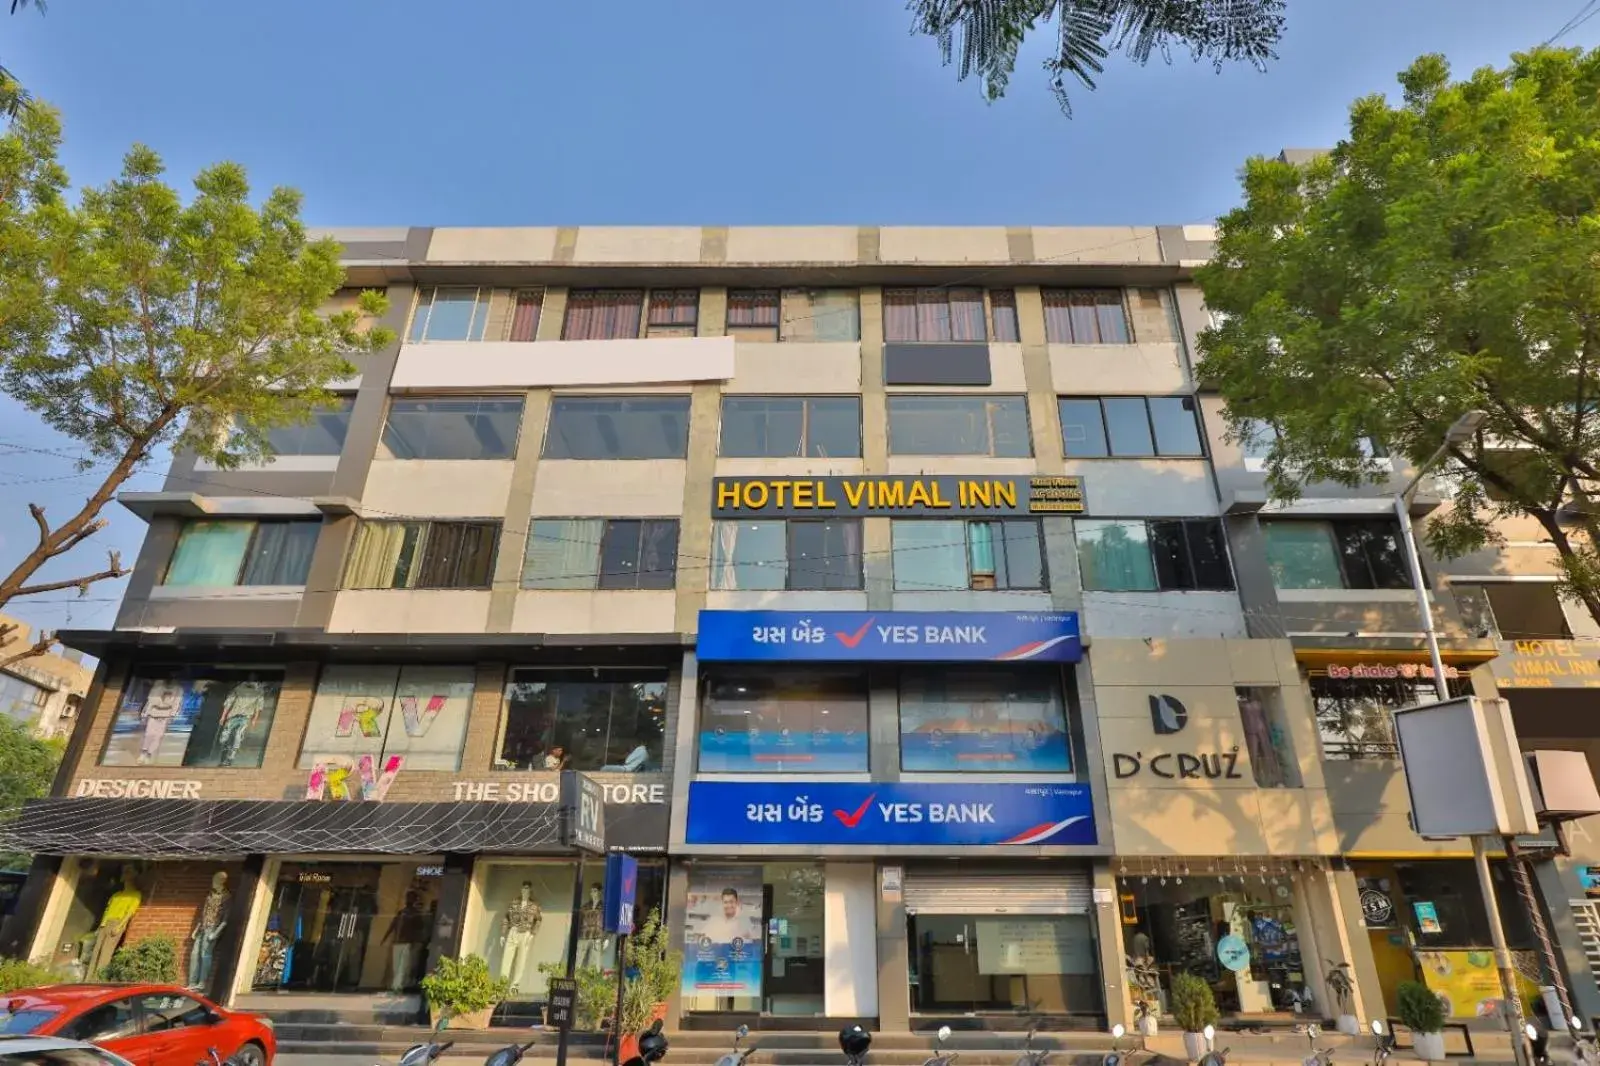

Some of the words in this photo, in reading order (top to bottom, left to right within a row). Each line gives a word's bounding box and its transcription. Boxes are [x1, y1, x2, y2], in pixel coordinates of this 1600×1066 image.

[717, 480, 836, 509] HOTEL
[843, 480, 952, 508] VIMAL
[959, 480, 1017, 508] INN
[752, 626, 786, 644] યસ
[876, 625, 918, 643] YES
[924, 625, 987, 644] BANK
[1514, 639, 1582, 657] HOTEL
[1328, 663, 1350, 679] Be
[1351, 662, 1398, 679] shake
[1509, 659, 1568, 676] VIMAL
[75, 779, 203, 800] DESIGNER
[451, 782, 502, 802] THE
[505, 782, 562, 803] SHO
[601, 784, 666, 804] TORE
[580, 792, 599, 832] RV
[746, 803, 782, 822] યસ
[878, 803, 923, 823] YES
[928, 803, 995, 823] BANK
